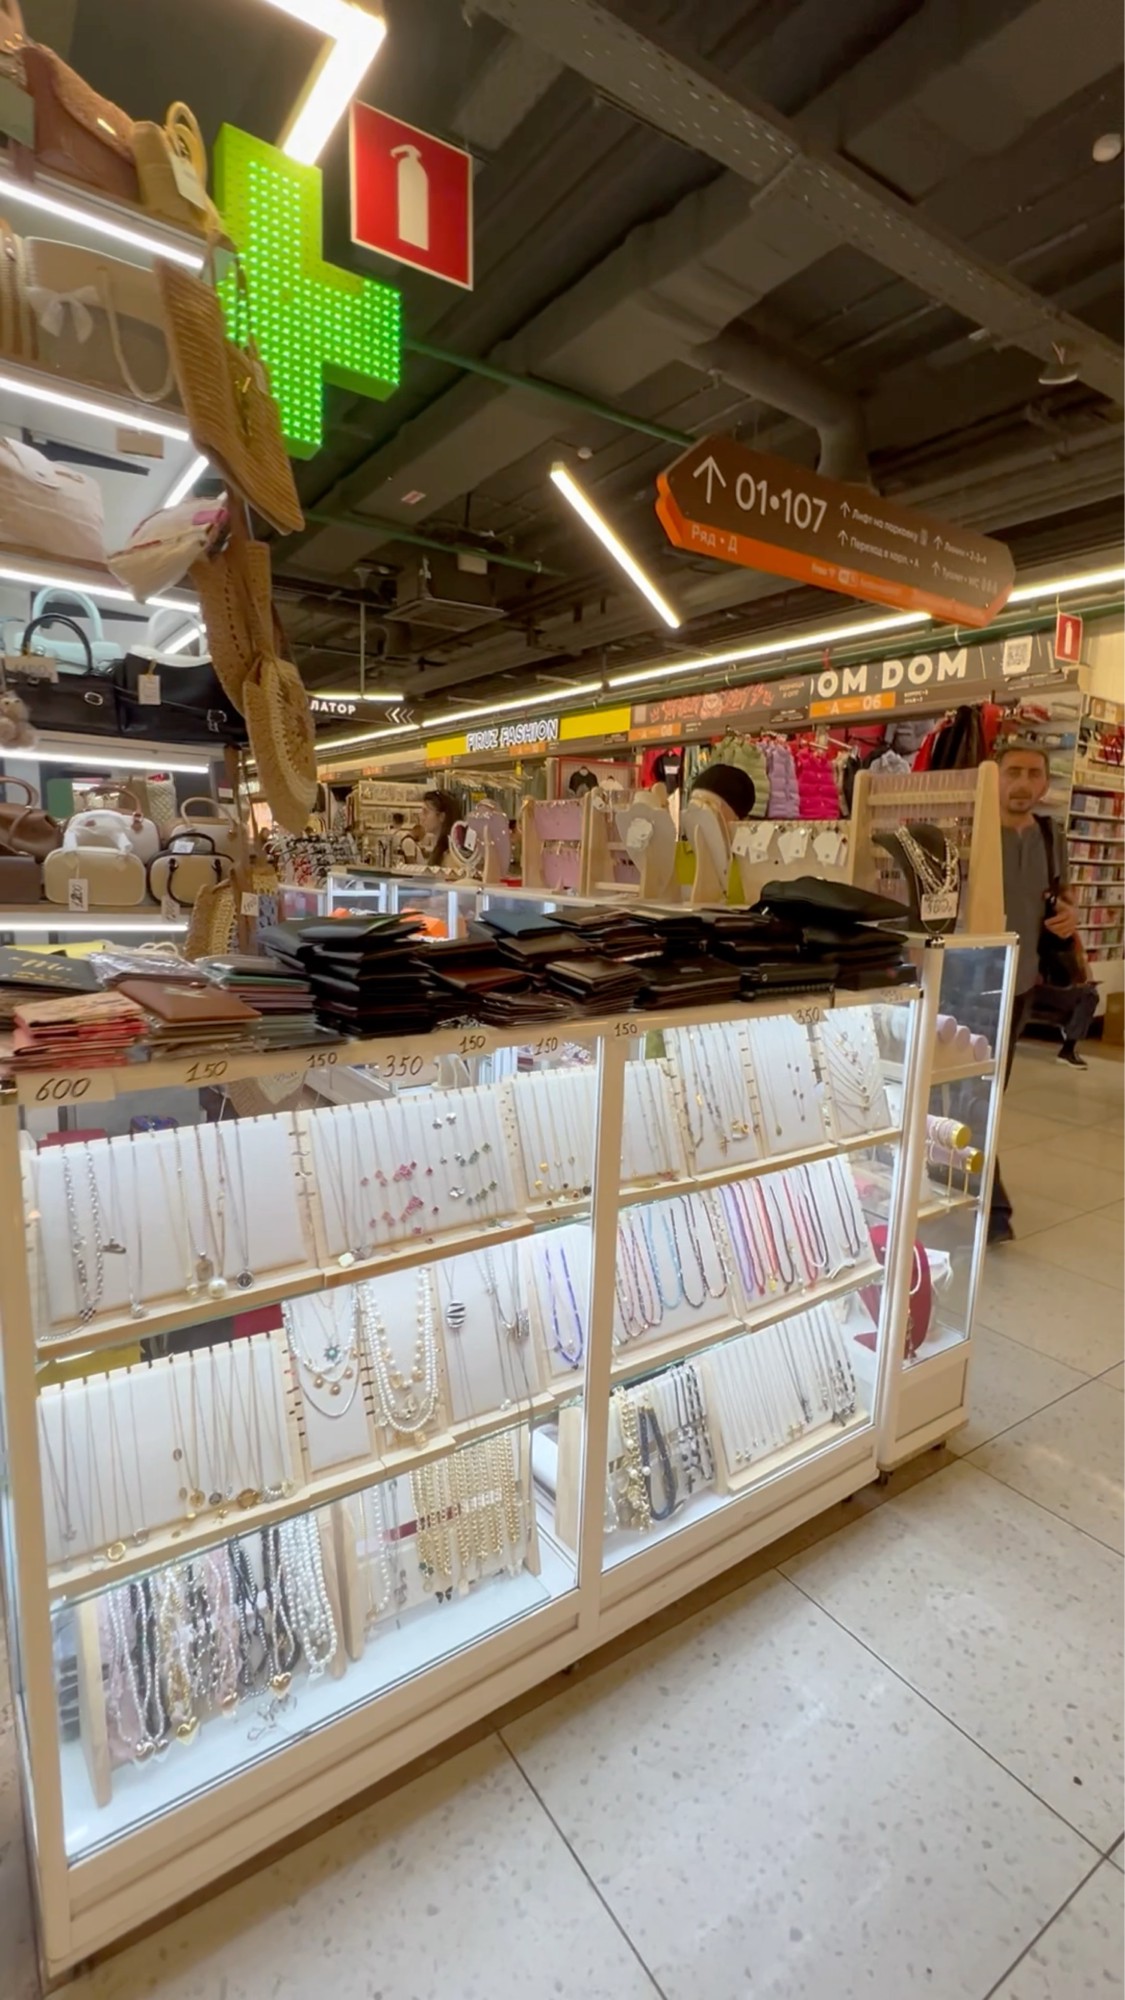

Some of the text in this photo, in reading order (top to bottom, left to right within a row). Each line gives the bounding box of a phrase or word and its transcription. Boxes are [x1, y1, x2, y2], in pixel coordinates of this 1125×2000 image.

[691, 524, 738, 554] Ряд Д
[850, 536, 883, 559] Переход
[810, 665, 868, 698] OM
[881, 648, 968, 690] DOM
[862, 694, 882, 711] 06
[467, 729, 498, 752] FIRUZ
[500, 718, 559, 746] FASHION
[796, 1007, 820, 1025] 350
[614, 1022, 638, 1037] 150
[459, 1035, 487, 1054] 150
[534, 1037, 558, 1056] 150
[306, 1052, 338, 1068] 150
[383, 1055, 424, 1077] 350
[185, 1061, 229, 1083] 150
[36, 1078, 91, 1101] 600
